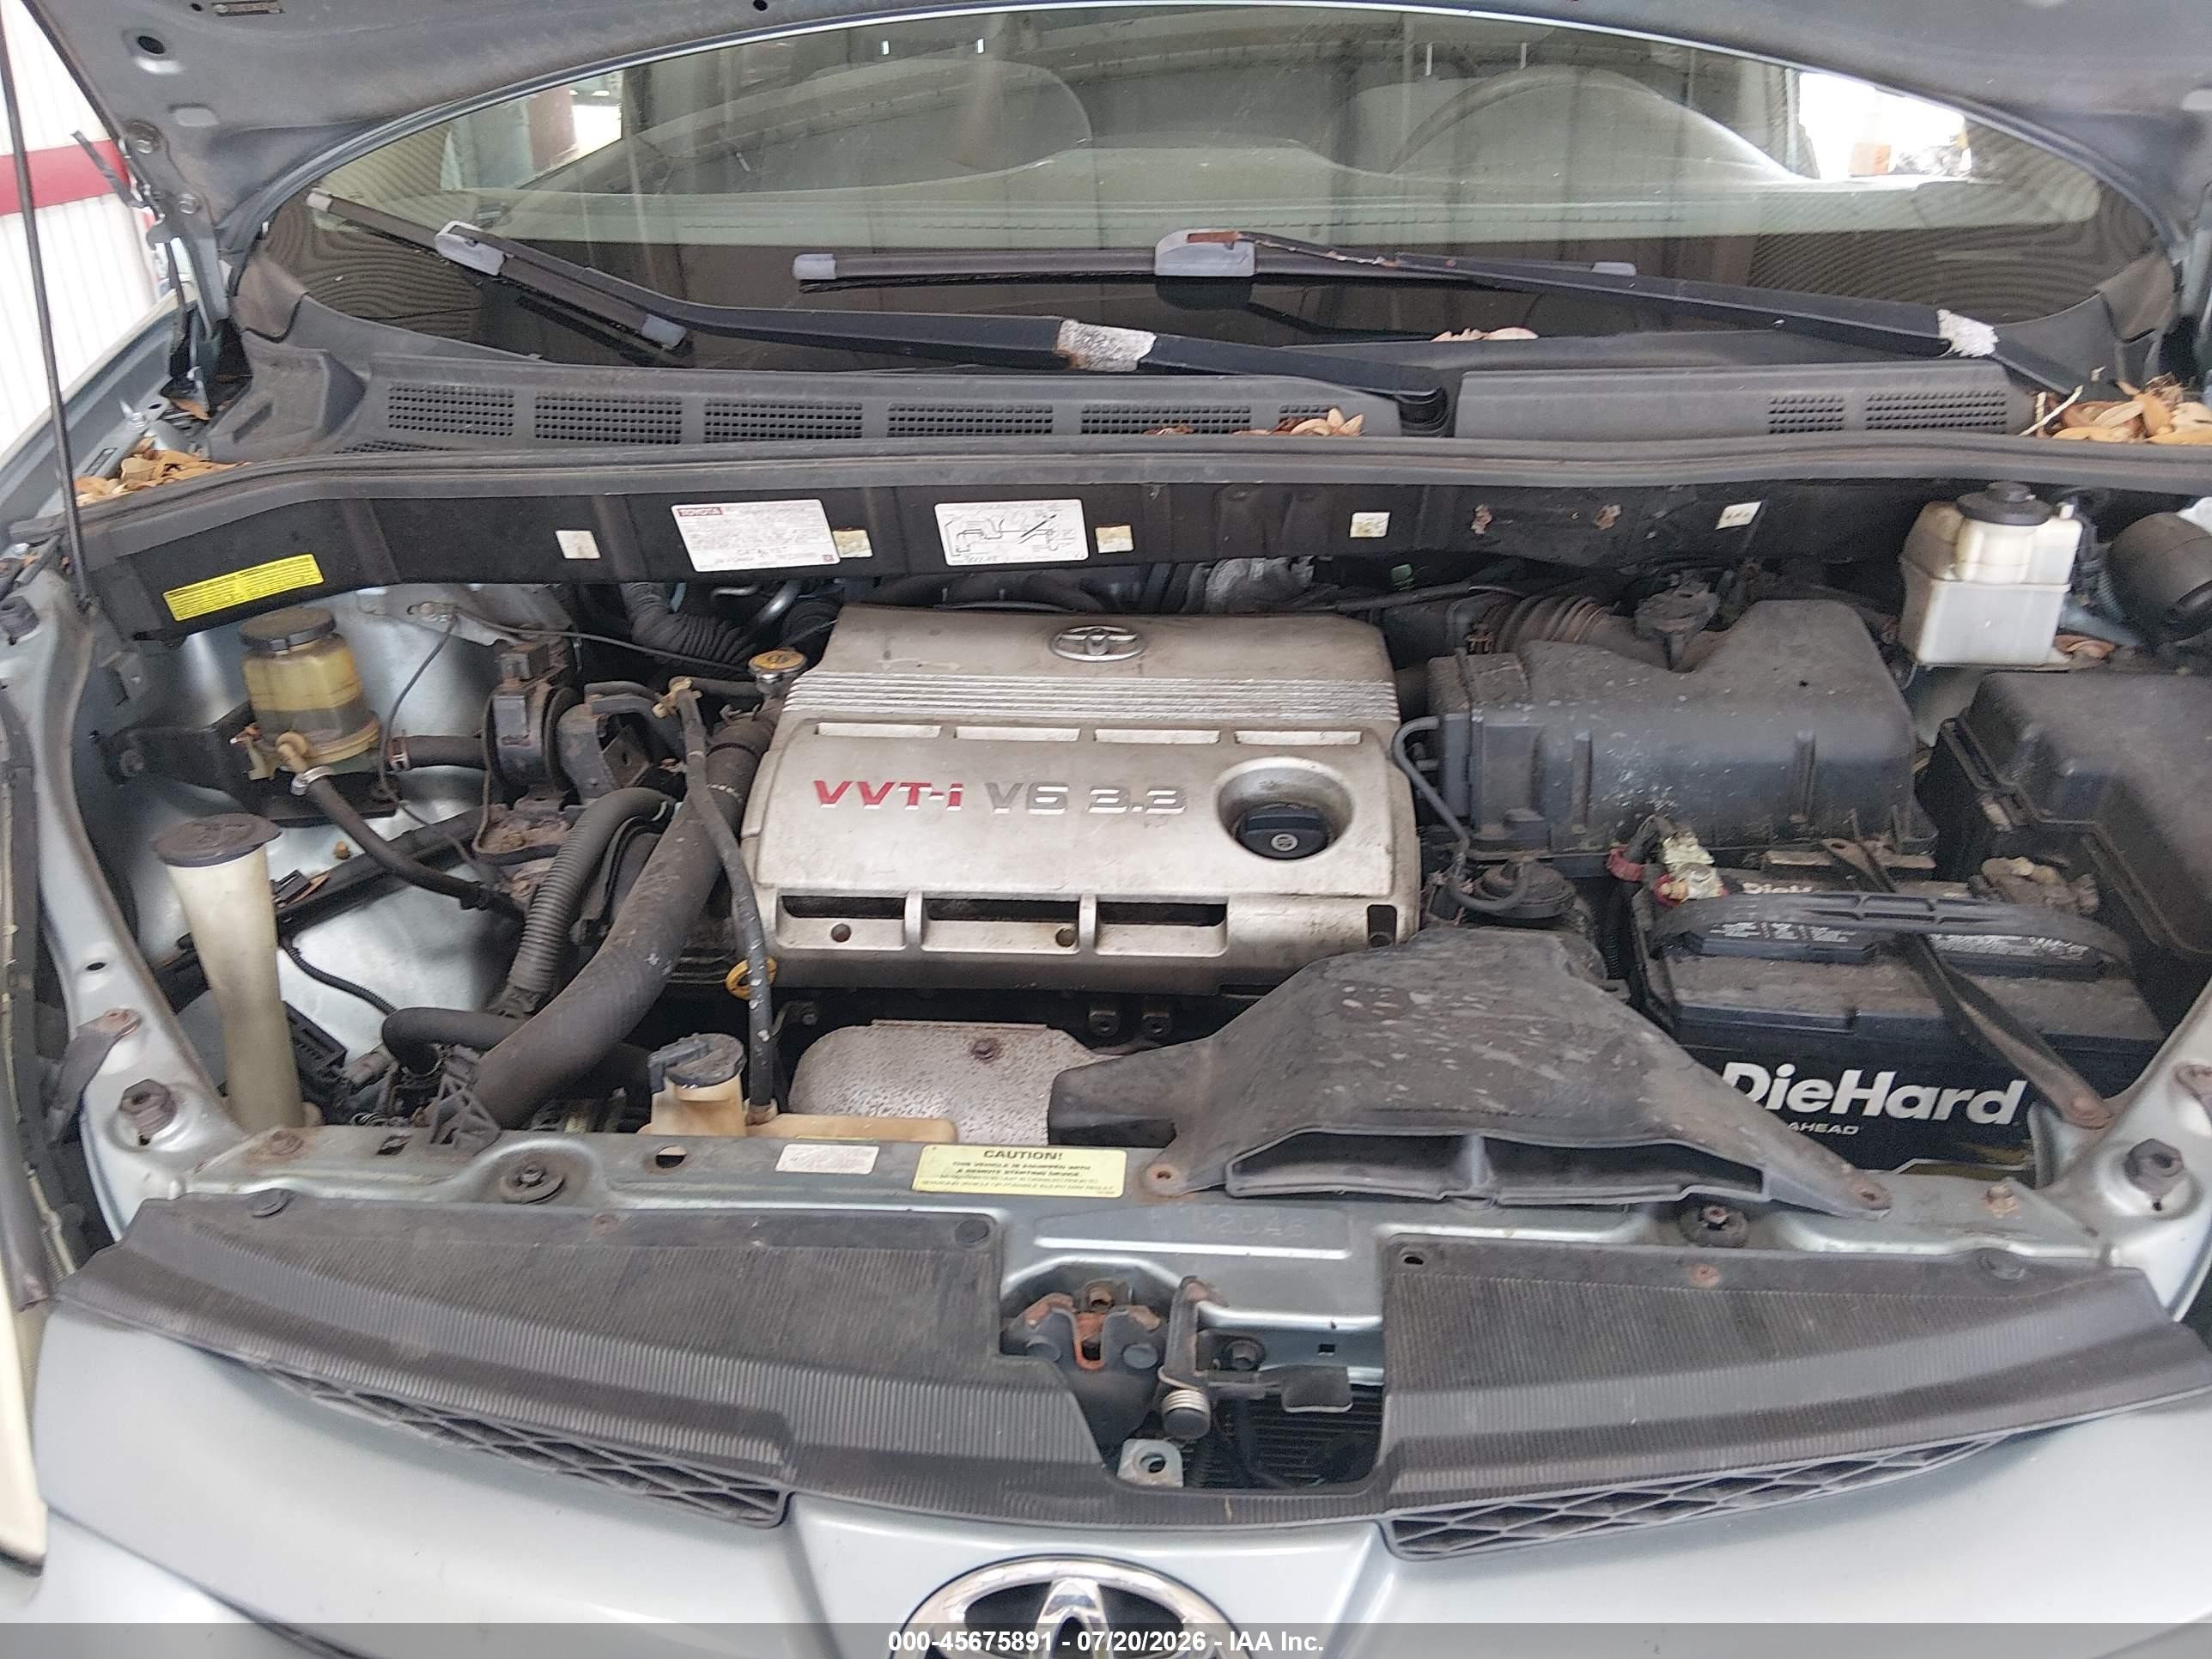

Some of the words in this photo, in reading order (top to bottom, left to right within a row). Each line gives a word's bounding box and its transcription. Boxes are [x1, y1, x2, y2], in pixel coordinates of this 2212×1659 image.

[814, 780, 963, 811] VVT-i
[985, 782, 1069, 815] V6
[1088, 785, 1188, 815] 3.3
[1723, 1061, 2027, 1125] DieHard
[983, 1149, 1064, 1160] CAUTION!
